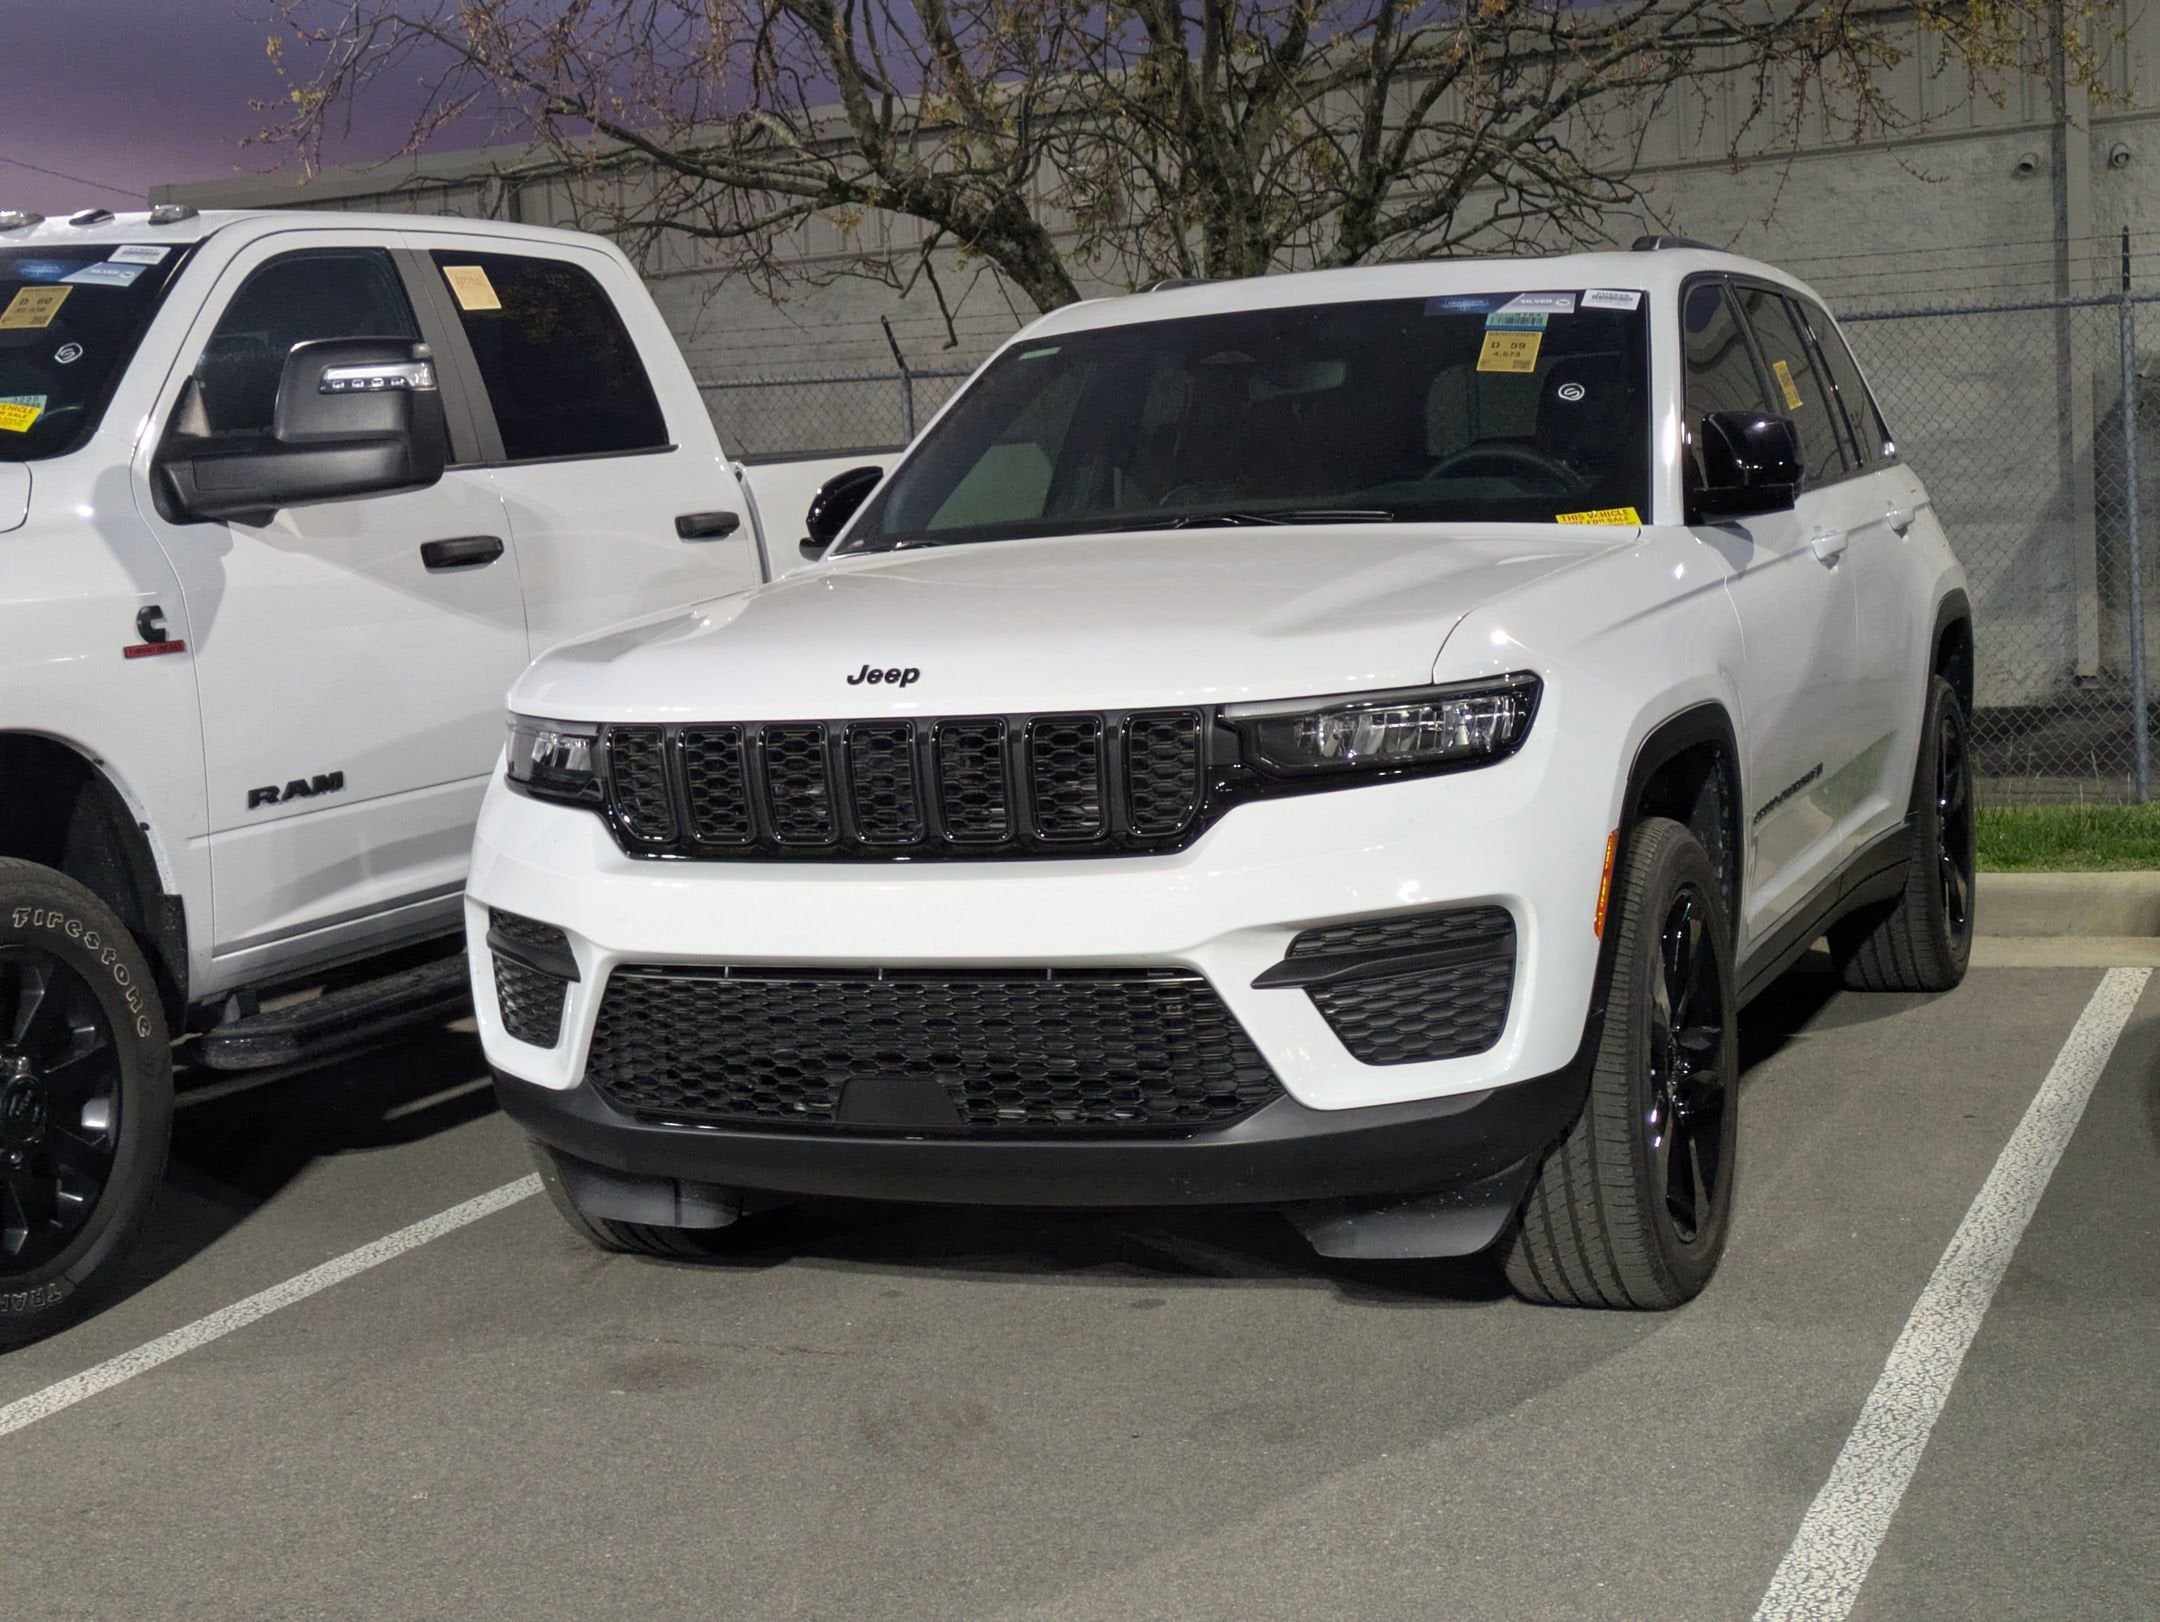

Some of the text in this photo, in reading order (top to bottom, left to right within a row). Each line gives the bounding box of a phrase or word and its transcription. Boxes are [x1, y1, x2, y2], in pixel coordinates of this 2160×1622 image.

[1561, 514, 1584, 522] THIS
[846, 664, 921, 688] Jeep
[247, 771, 345, 809] RAM
